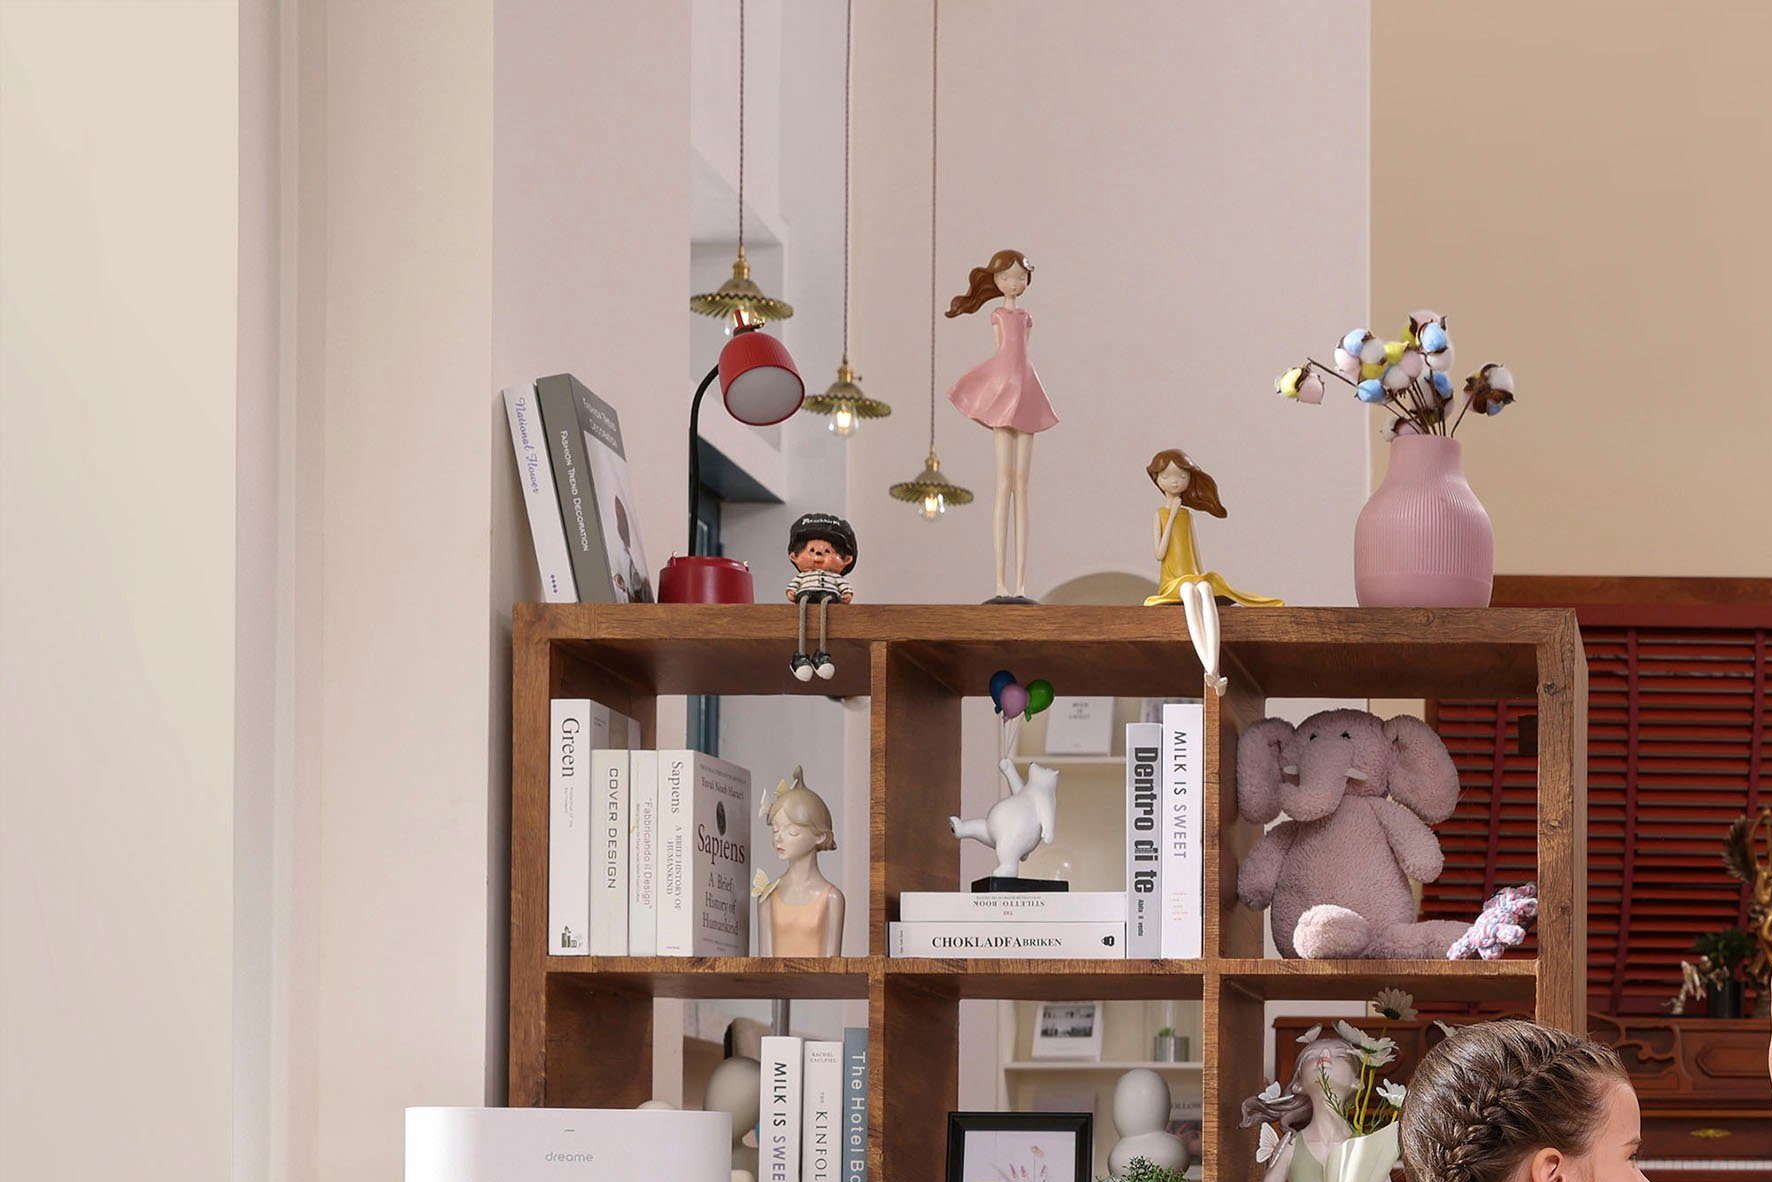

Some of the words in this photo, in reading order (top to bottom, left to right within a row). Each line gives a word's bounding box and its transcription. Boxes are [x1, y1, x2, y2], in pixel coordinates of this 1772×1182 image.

[573, 498, 590, 552] DECORATION
[561, 717, 580, 778] Green
[1173, 731, 1188, 773] MILK
[608, 768, 619, 822] COVER
[668, 761, 684, 814] Sapiens
[1134, 747, 1159, 831] Dentro
[1173, 782, 1187, 796] IS
[697, 824, 745, 865] Sapiens
[1134, 840, 1159, 862] di
[1173, 804, 1187, 859] SWEET
[607, 828, 618, 889] DESIGN
[665, 841, 675, 895] HUMANKIND
[673, 861, 683, 897] HISTORY
[1134, 869, 1159, 894] te
[932, 936, 1063, 949] CHOKLADFABRIKEN
[773, 1061, 787, 1104] MILK
[850, 1052, 866, 1089] The
[773, 1113, 786, 1127] IS
[849, 1097, 866, 1152] Hotel
[545, 1151, 594, 1163] dreame
